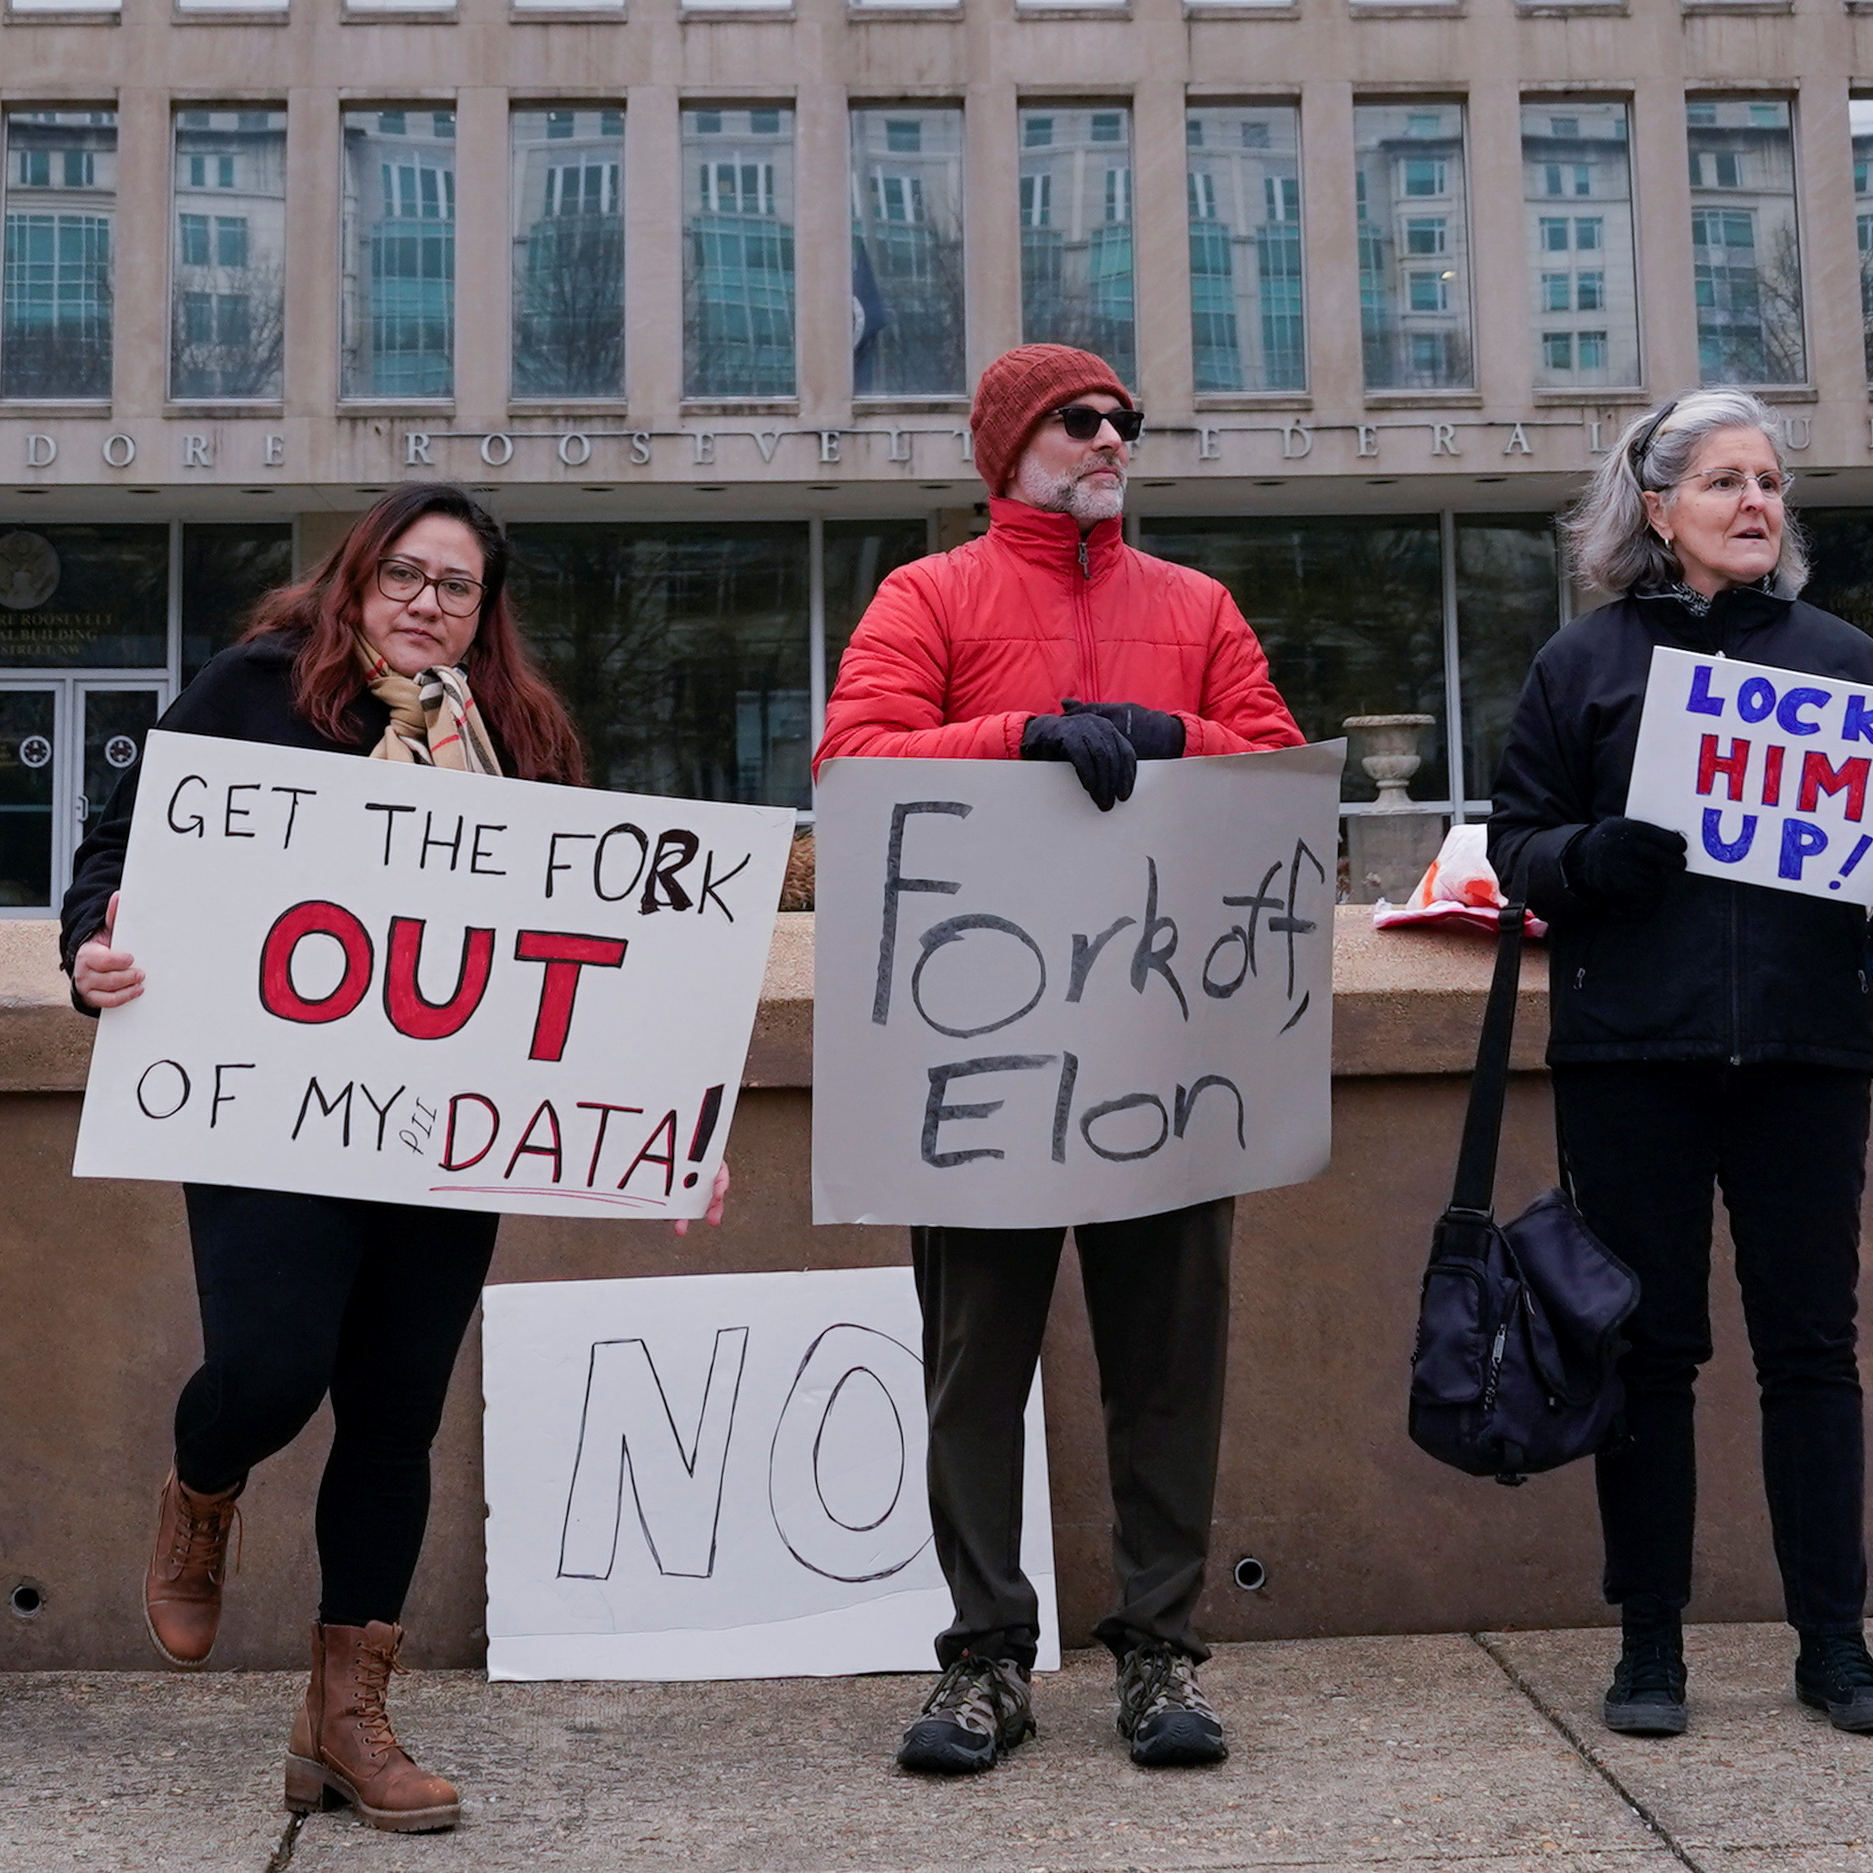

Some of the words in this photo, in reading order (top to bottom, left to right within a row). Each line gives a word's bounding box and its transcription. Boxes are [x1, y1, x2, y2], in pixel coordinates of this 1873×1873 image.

[404, 430, 973, 467] ROOSEVELT
[1695, 733, 1873, 824] HIM
[166, 773, 318, 850] GET
[364, 802, 509, 877] THE
[544, 822, 753, 924] FORK
[258, 899, 629, 1063] OUT
[870, 800, 1190, 1040] Fork
[136, 1058, 257, 1129] OF
[291, 1076, 406, 1152] MY
[920, 1051, 1247, 1170] Elon
[555, 1321, 936, 1584] NO
